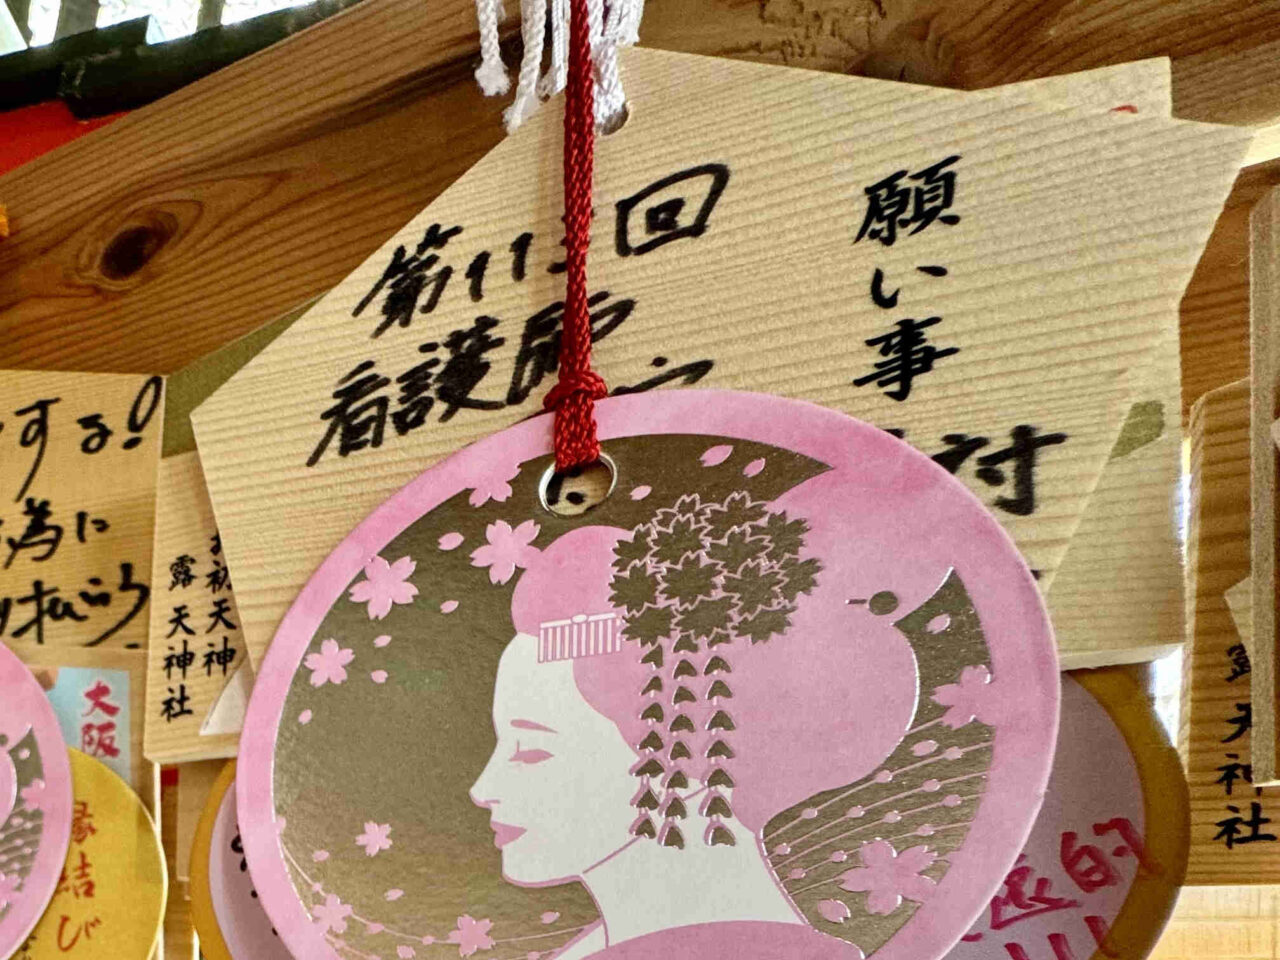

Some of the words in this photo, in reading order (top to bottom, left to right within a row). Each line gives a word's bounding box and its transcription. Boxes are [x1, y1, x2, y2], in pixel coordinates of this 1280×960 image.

[854, 154, 962, 402] 願い事
[80, 680, 122, 760] 大阪
[160, 554, 196, 723] 露天神社
